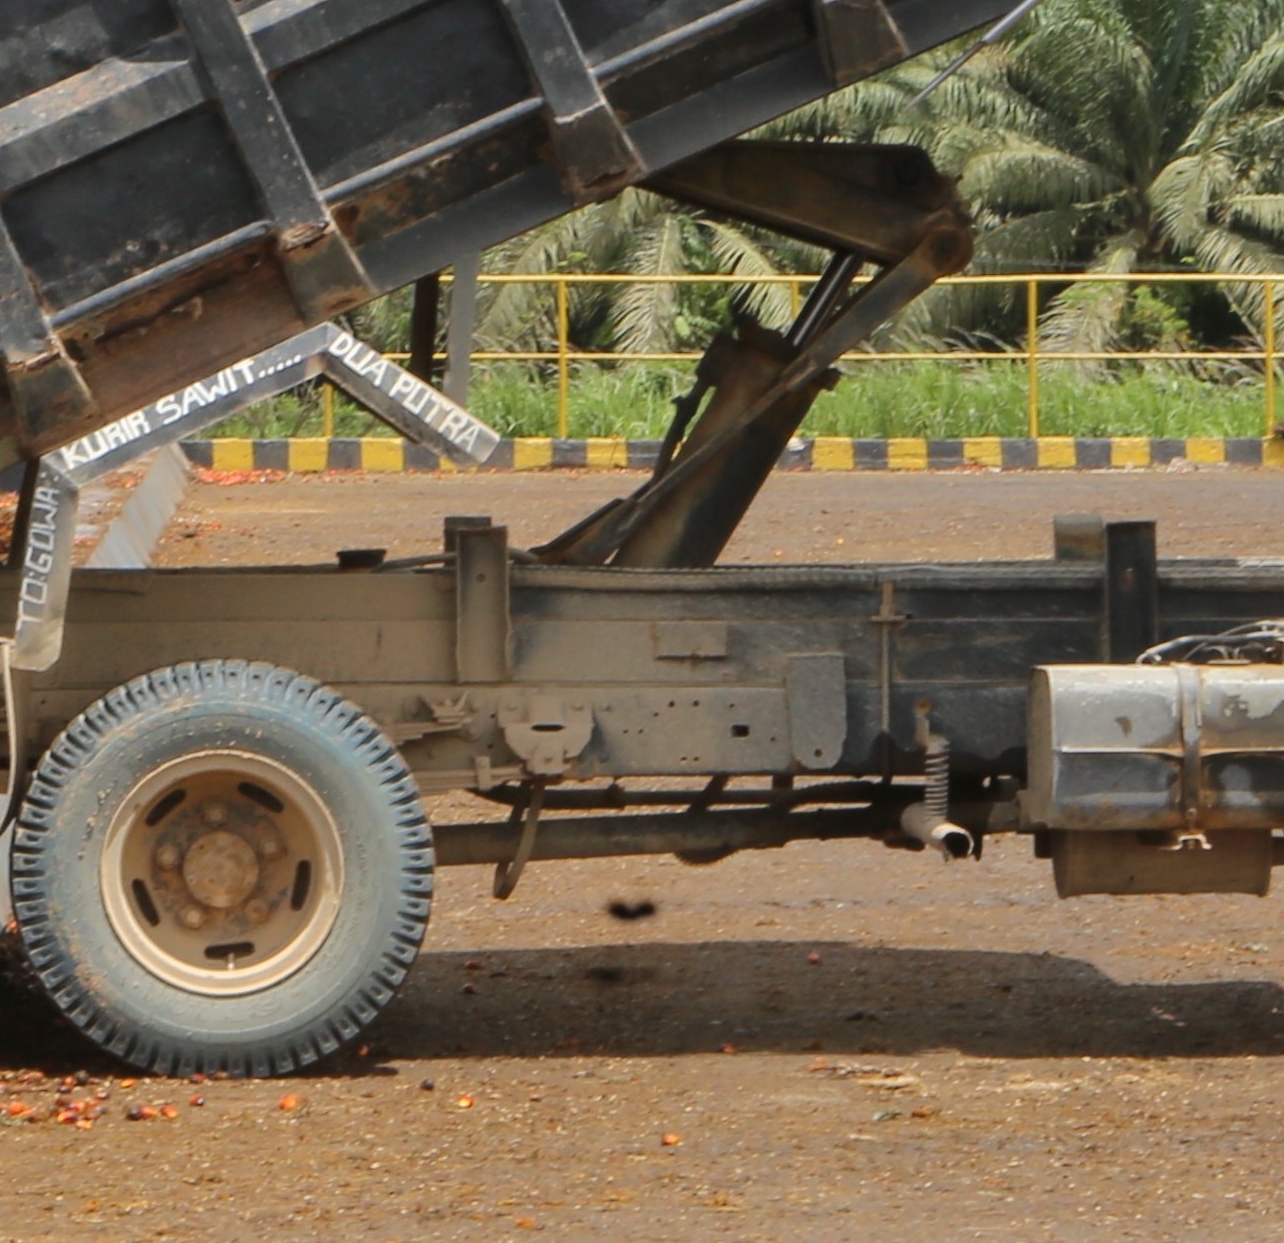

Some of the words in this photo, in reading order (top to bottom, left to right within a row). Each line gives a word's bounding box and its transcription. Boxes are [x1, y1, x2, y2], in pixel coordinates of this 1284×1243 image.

[328, 332, 389, 387] DUA
[388, 372, 482, 454] PUTRA
[61, 410, 151, 470] KURIR
